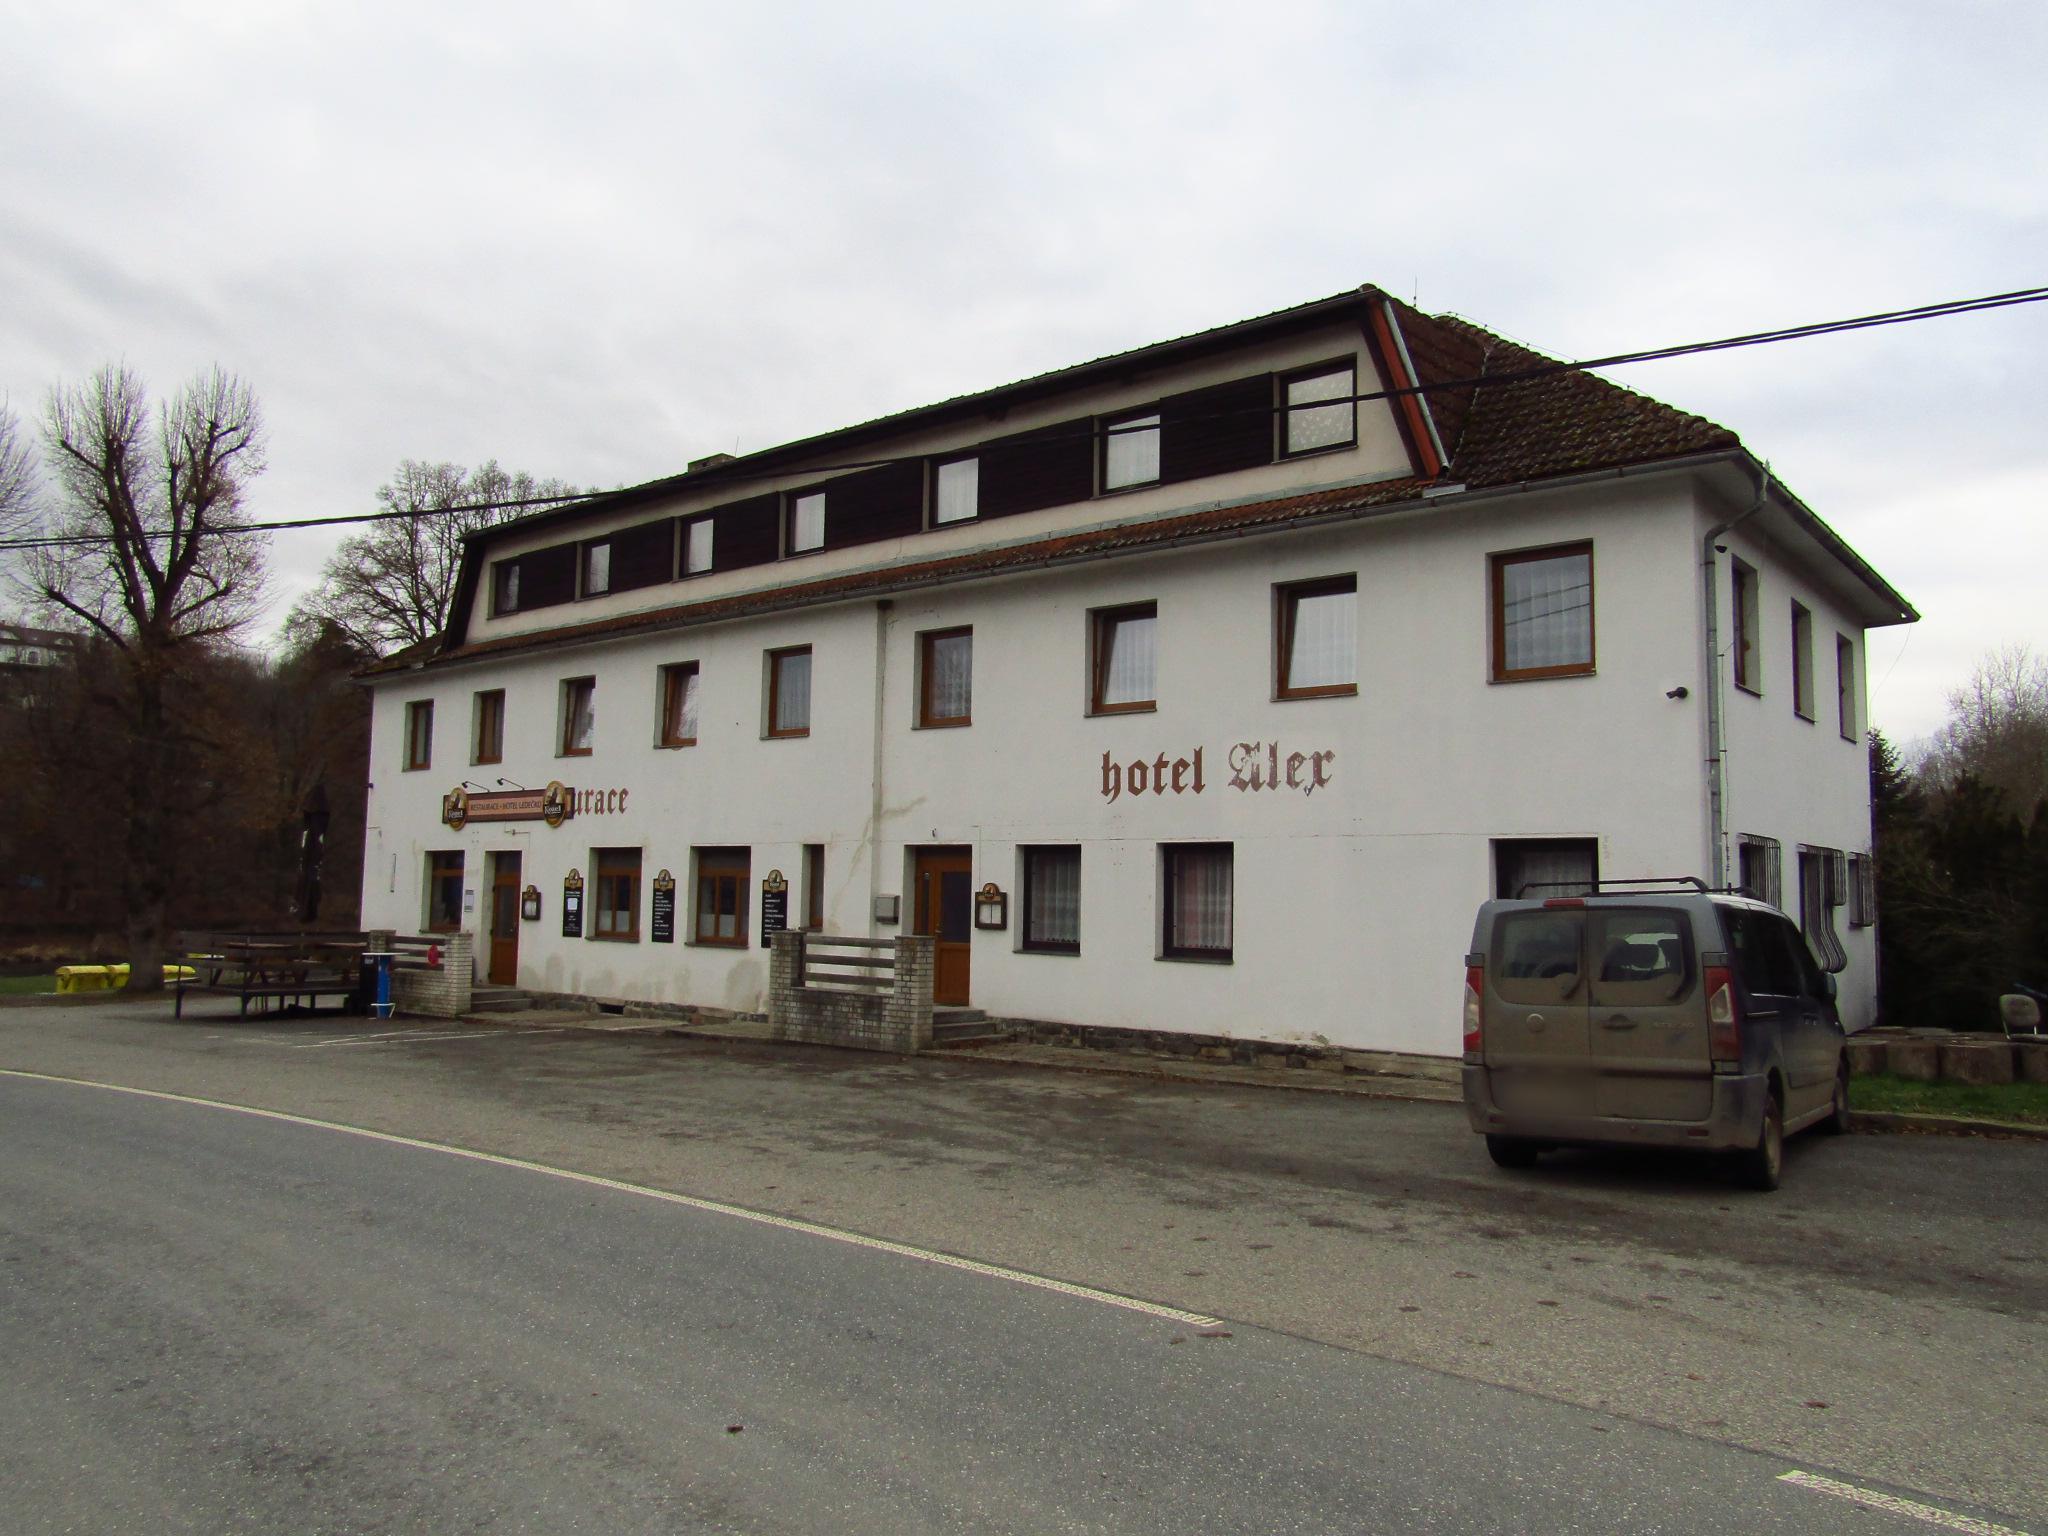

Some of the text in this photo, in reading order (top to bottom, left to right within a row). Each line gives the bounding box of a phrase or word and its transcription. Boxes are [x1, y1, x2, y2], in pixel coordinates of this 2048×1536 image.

[1100, 740, 1336, 805] hotel Alex
[471, 803, 499, 812] RESTAURACE
[503, 801, 518, 810] HOTEL
